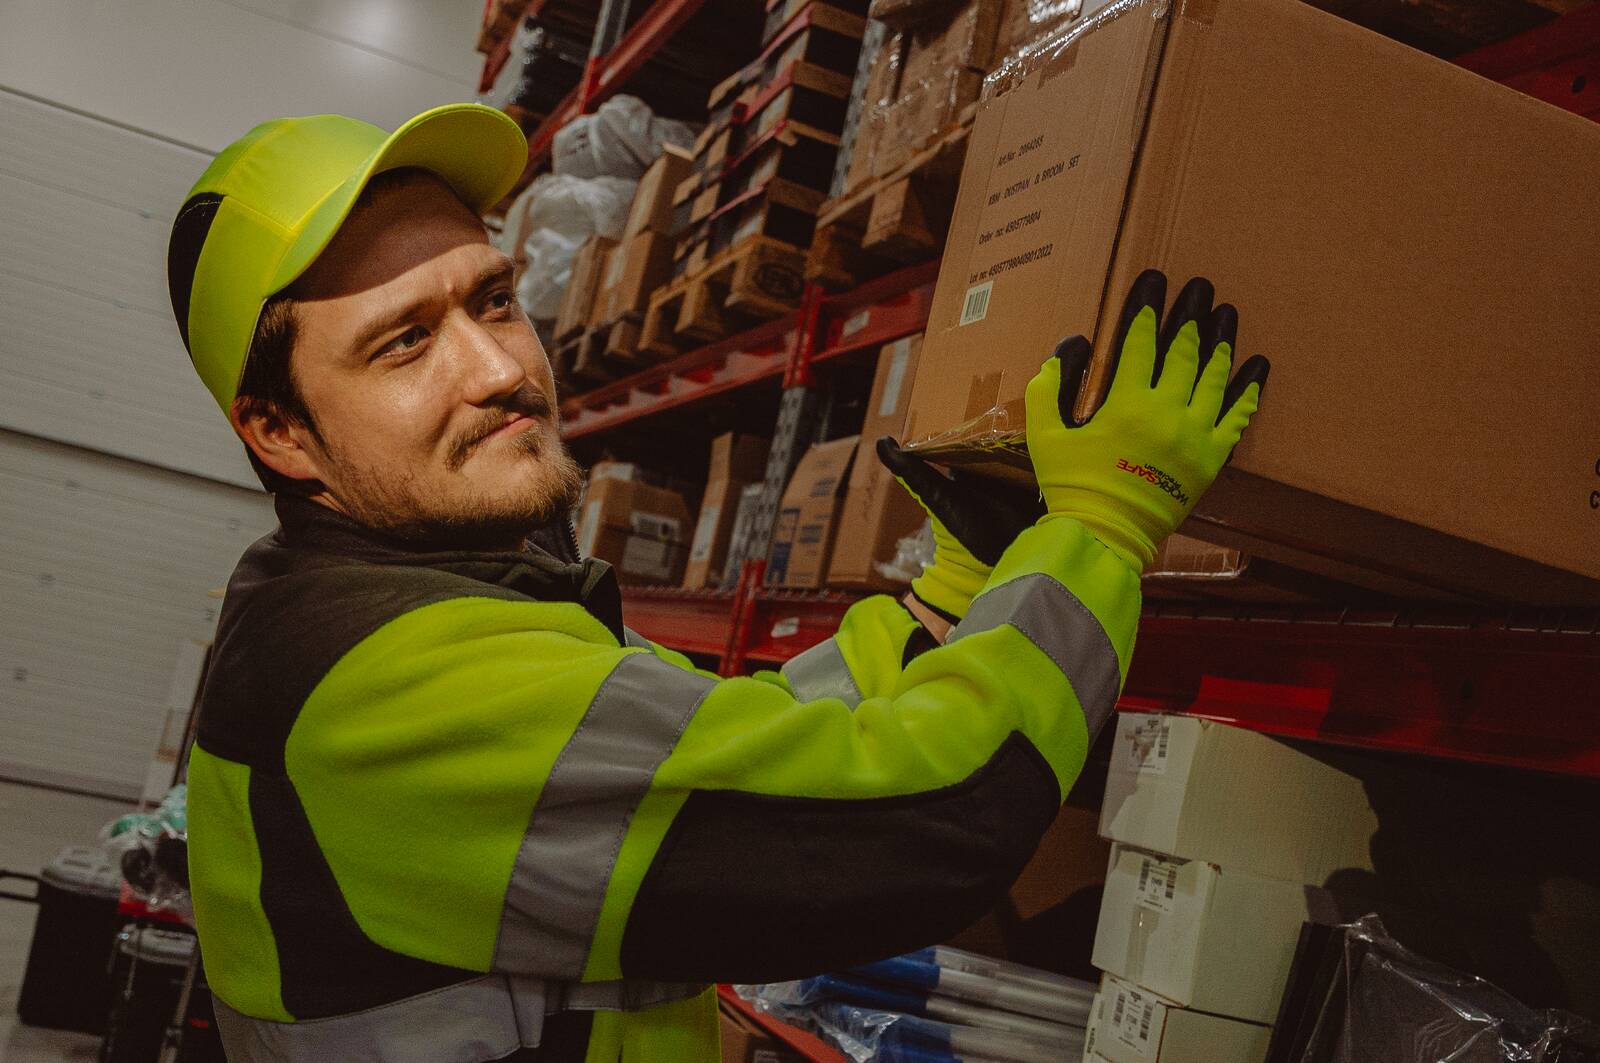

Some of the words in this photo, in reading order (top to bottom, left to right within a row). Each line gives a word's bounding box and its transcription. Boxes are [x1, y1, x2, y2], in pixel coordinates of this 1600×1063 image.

[1004, 178, 1031, 199] DUSTPAN
[1034, 174, 1040, 185] &
[1042, 161, 1065, 181] BROOM
[1067, 154, 1081, 170] SET
[979, 230, 994, 245] Order
[969, 272, 979, 284] Lot
[1116, 458, 1189, 506] WORKSAFE
